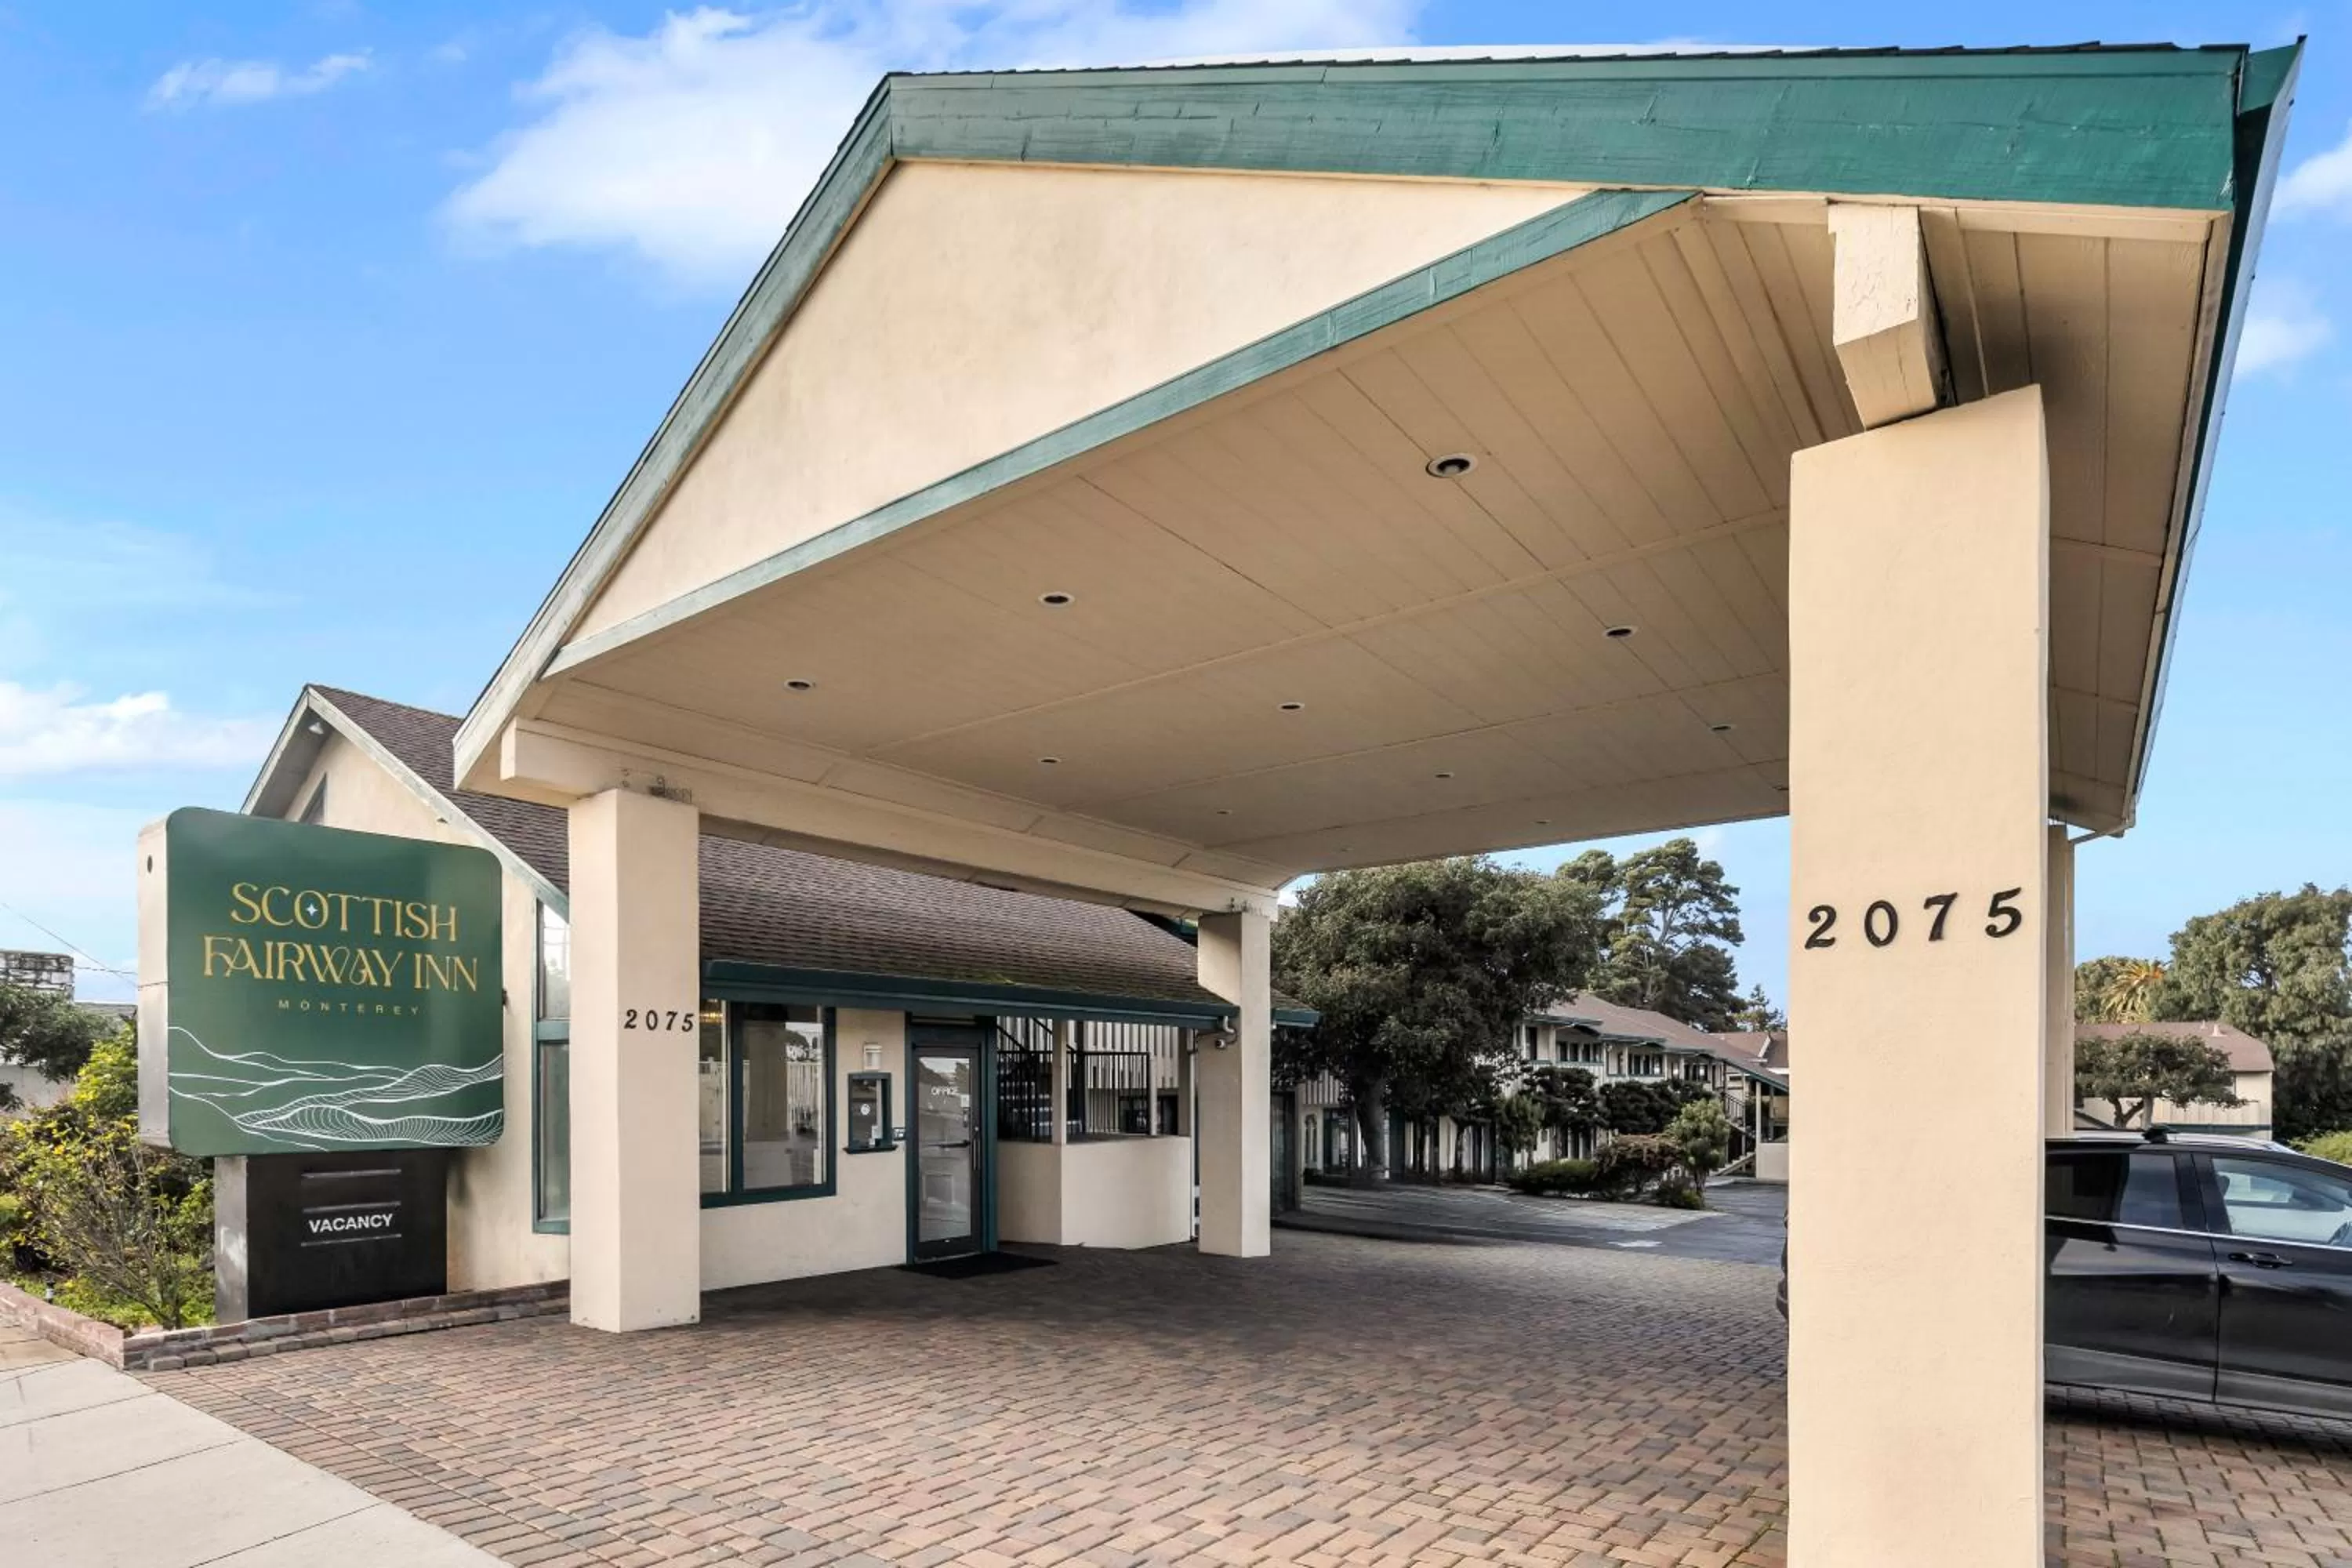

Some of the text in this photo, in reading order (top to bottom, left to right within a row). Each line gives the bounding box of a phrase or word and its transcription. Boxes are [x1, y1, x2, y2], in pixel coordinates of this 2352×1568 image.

[230, 882, 458, 942] SCOTTISH
[1804, 887, 2023, 949] 2075
[203, 935, 477, 992] FAIRWAY INN
[278, 999, 420, 1014] MONTEREY
[624, 1009, 695, 1032] 2075
[308, 1213, 393, 1233] VACANCY
